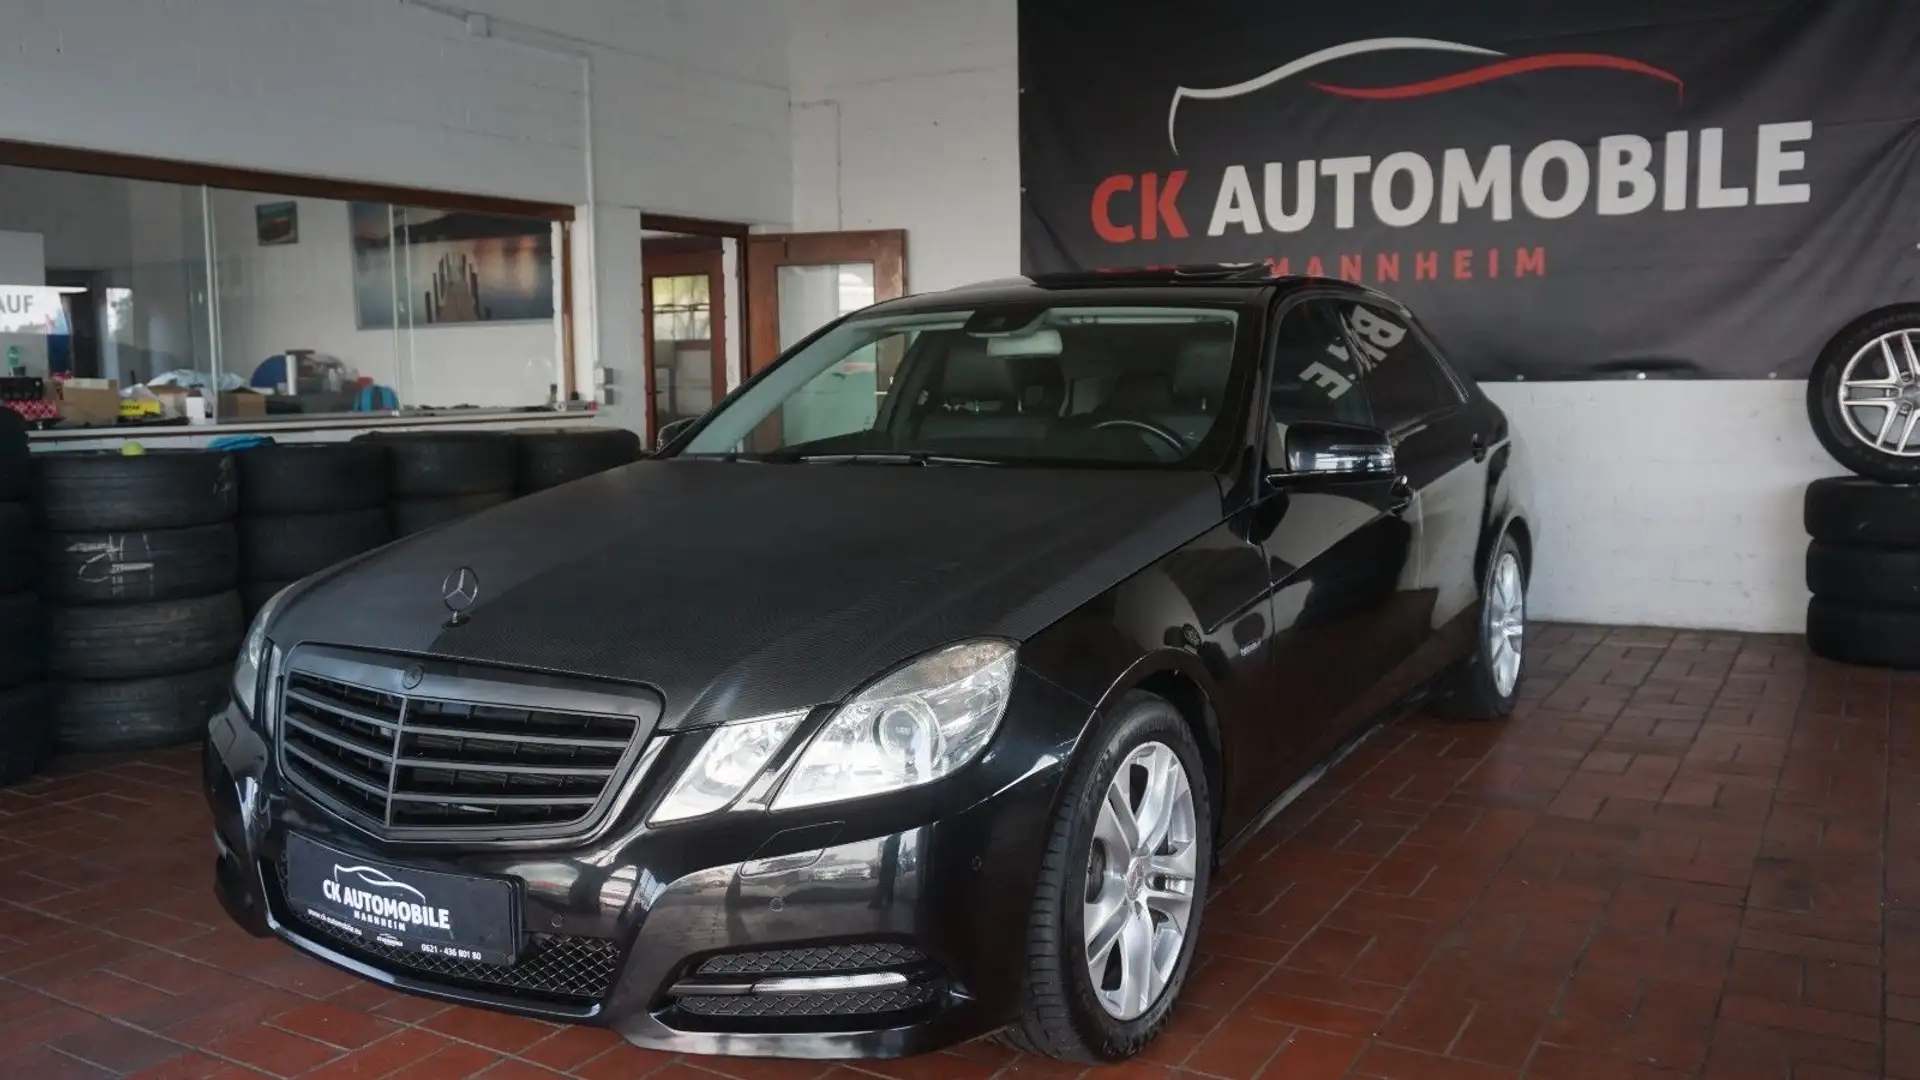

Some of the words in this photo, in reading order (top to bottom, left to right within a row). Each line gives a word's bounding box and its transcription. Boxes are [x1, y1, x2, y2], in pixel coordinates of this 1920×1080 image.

[1090, 170, 1189, 243] CK
[1207, 120, 1812, 236] AUTOMOBILE
[1266, 246, 1546, 283] MANNHEIM
[323, 879, 342, 903] CK
[343, 886, 450, 929] AUTOMOBILE
[354, 910, 406, 932] MANNHEIM
[421, 943, 438, 954] 0621
[443, 946, 457, 957] 436
